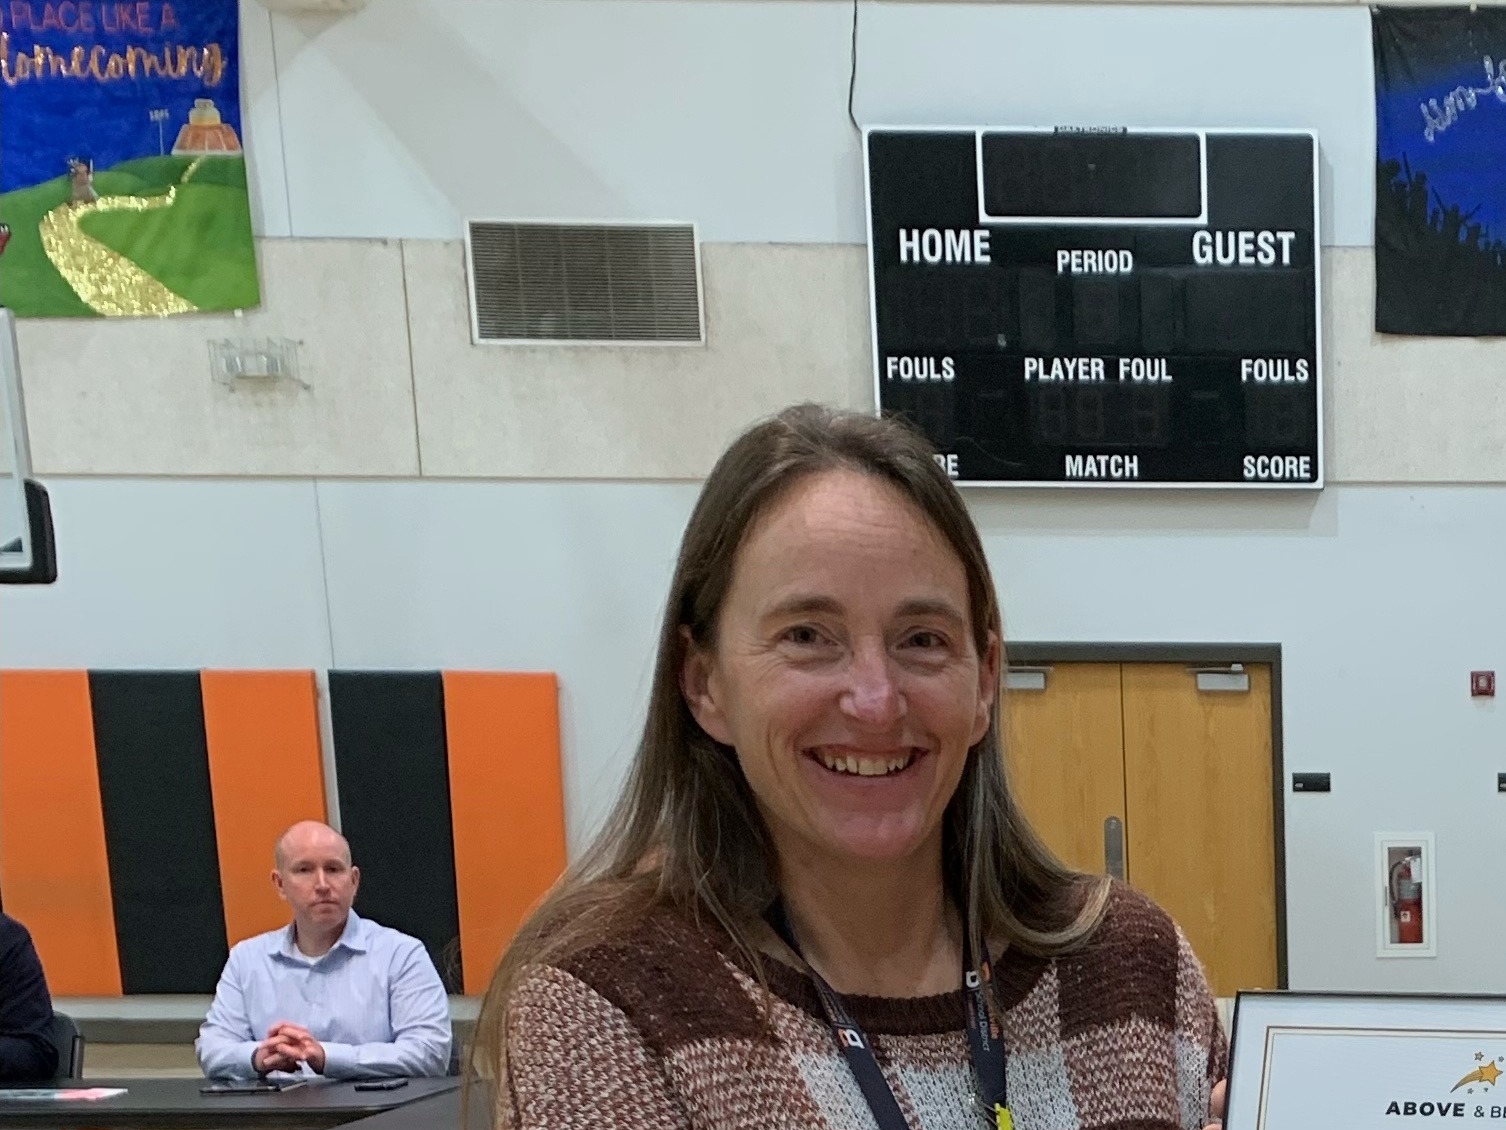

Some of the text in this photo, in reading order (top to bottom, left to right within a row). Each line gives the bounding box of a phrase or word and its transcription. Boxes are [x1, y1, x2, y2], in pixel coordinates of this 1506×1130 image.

[10, 1, 180, 34] PLACE LIKE A
[899, 229, 1295, 265] HOME GUEST
[1057, 250, 1133, 273] PERIOD
[887, 357, 955, 380] FOULS
[1024, 357, 1172, 381] PLAYER FOUL
[1241, 358, 1309, 381] FOULS
[1065, 455, 1138, 478] MATCH
[1243, 456, 1310, 479] SCORE
[1385, 1101, 1466, 1117] ABOVE
[1473, 1106, 1485, 1118] &
